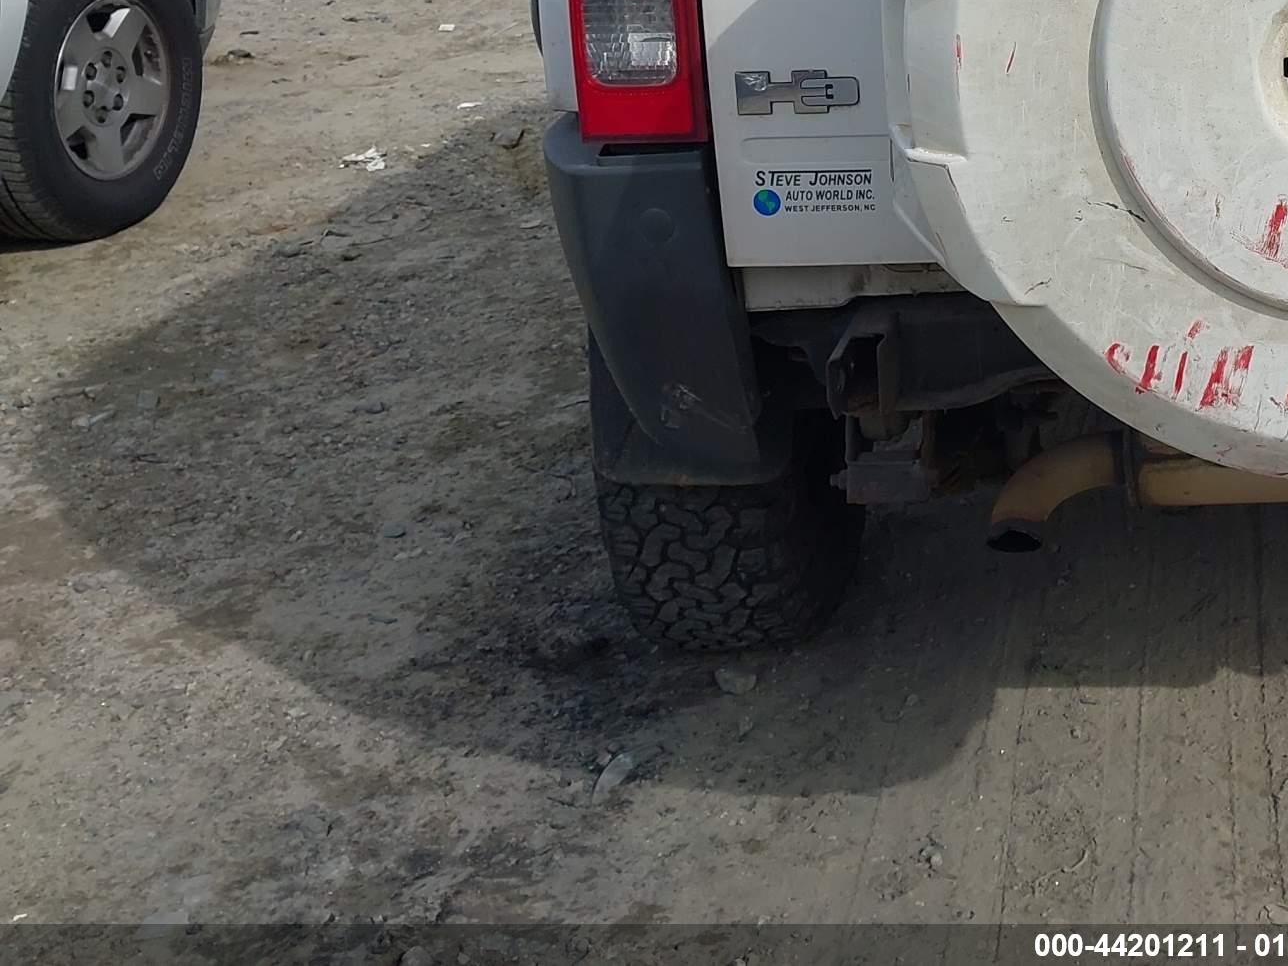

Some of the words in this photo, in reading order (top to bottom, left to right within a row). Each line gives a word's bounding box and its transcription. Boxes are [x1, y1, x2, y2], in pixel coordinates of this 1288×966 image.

[735, 69, 861, 116] H3
[755, 170, 801, 186] STEVE
[808, 169, 872, 186] JOHNSON
[785, 190, 813, 201] AUTO
[815, 190, 853, 201] WORLD
[855, 189, 875, 200] INC.
[811, 204, 863, 213] JEFFERSON,
